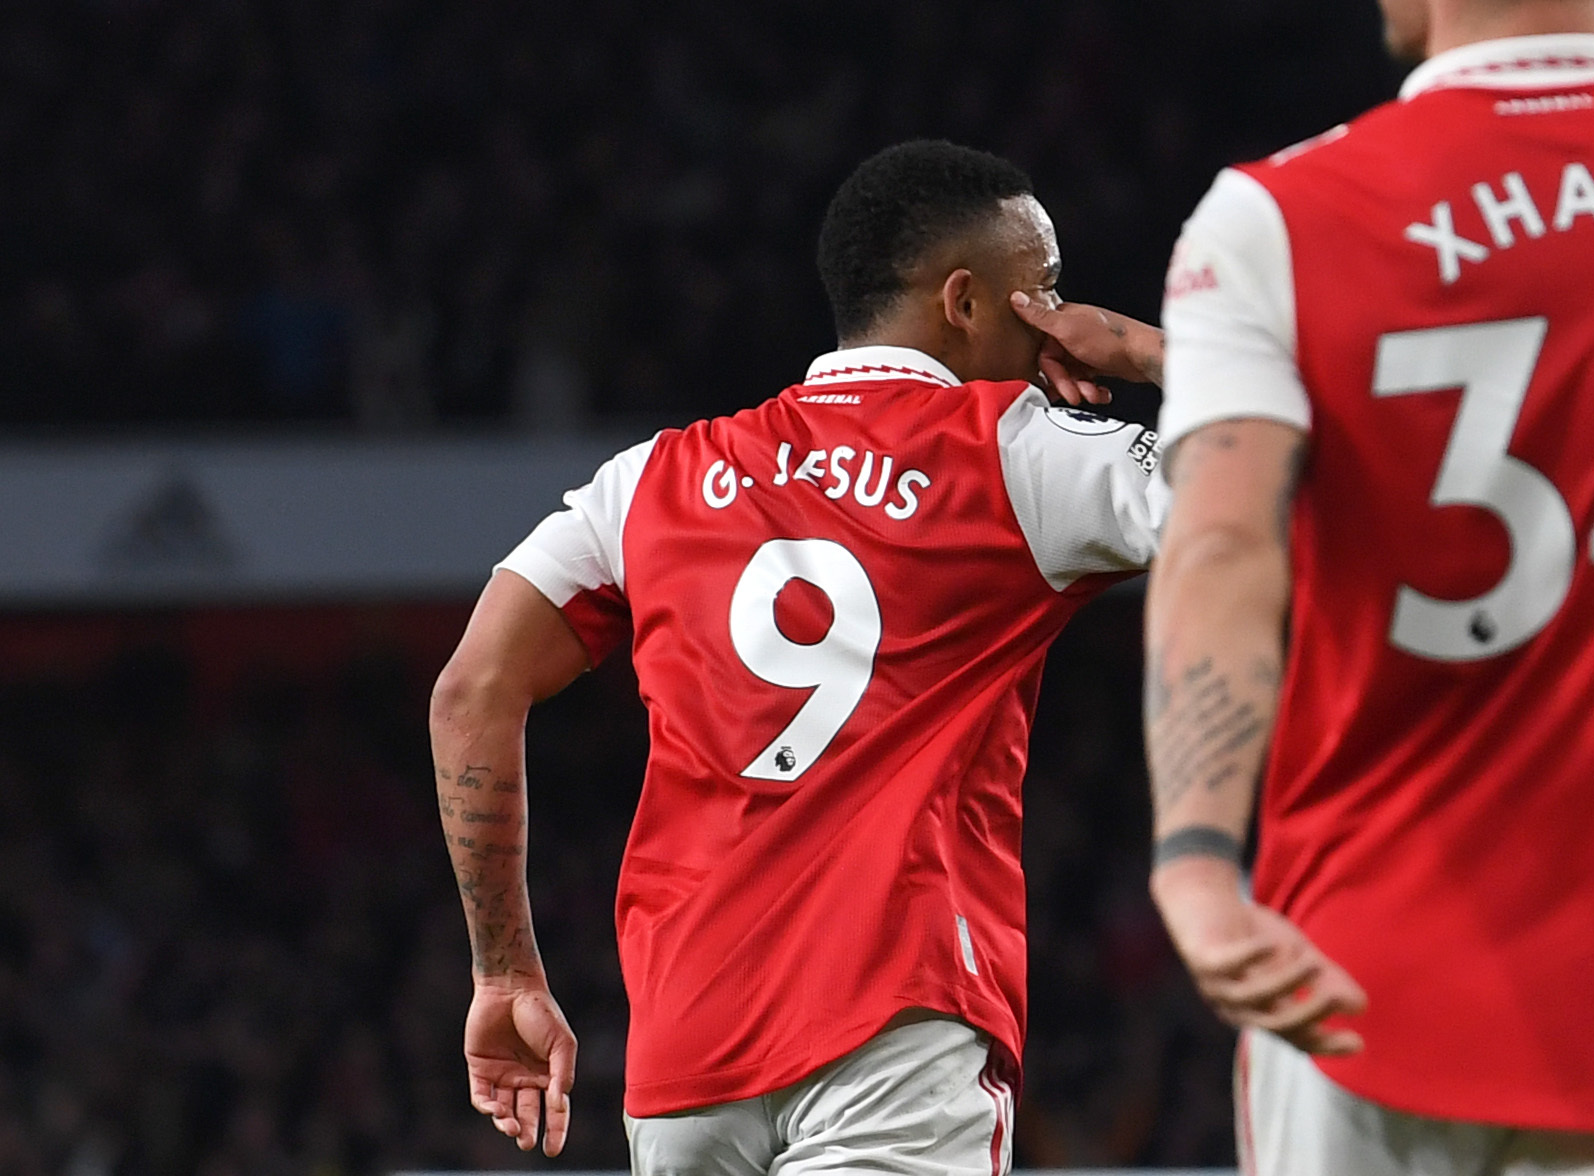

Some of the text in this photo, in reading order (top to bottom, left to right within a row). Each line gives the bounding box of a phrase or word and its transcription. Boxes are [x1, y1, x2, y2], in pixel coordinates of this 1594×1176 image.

[702, 441, 931, 521] G. JESUS
[730, 537, 882, 782] 9
